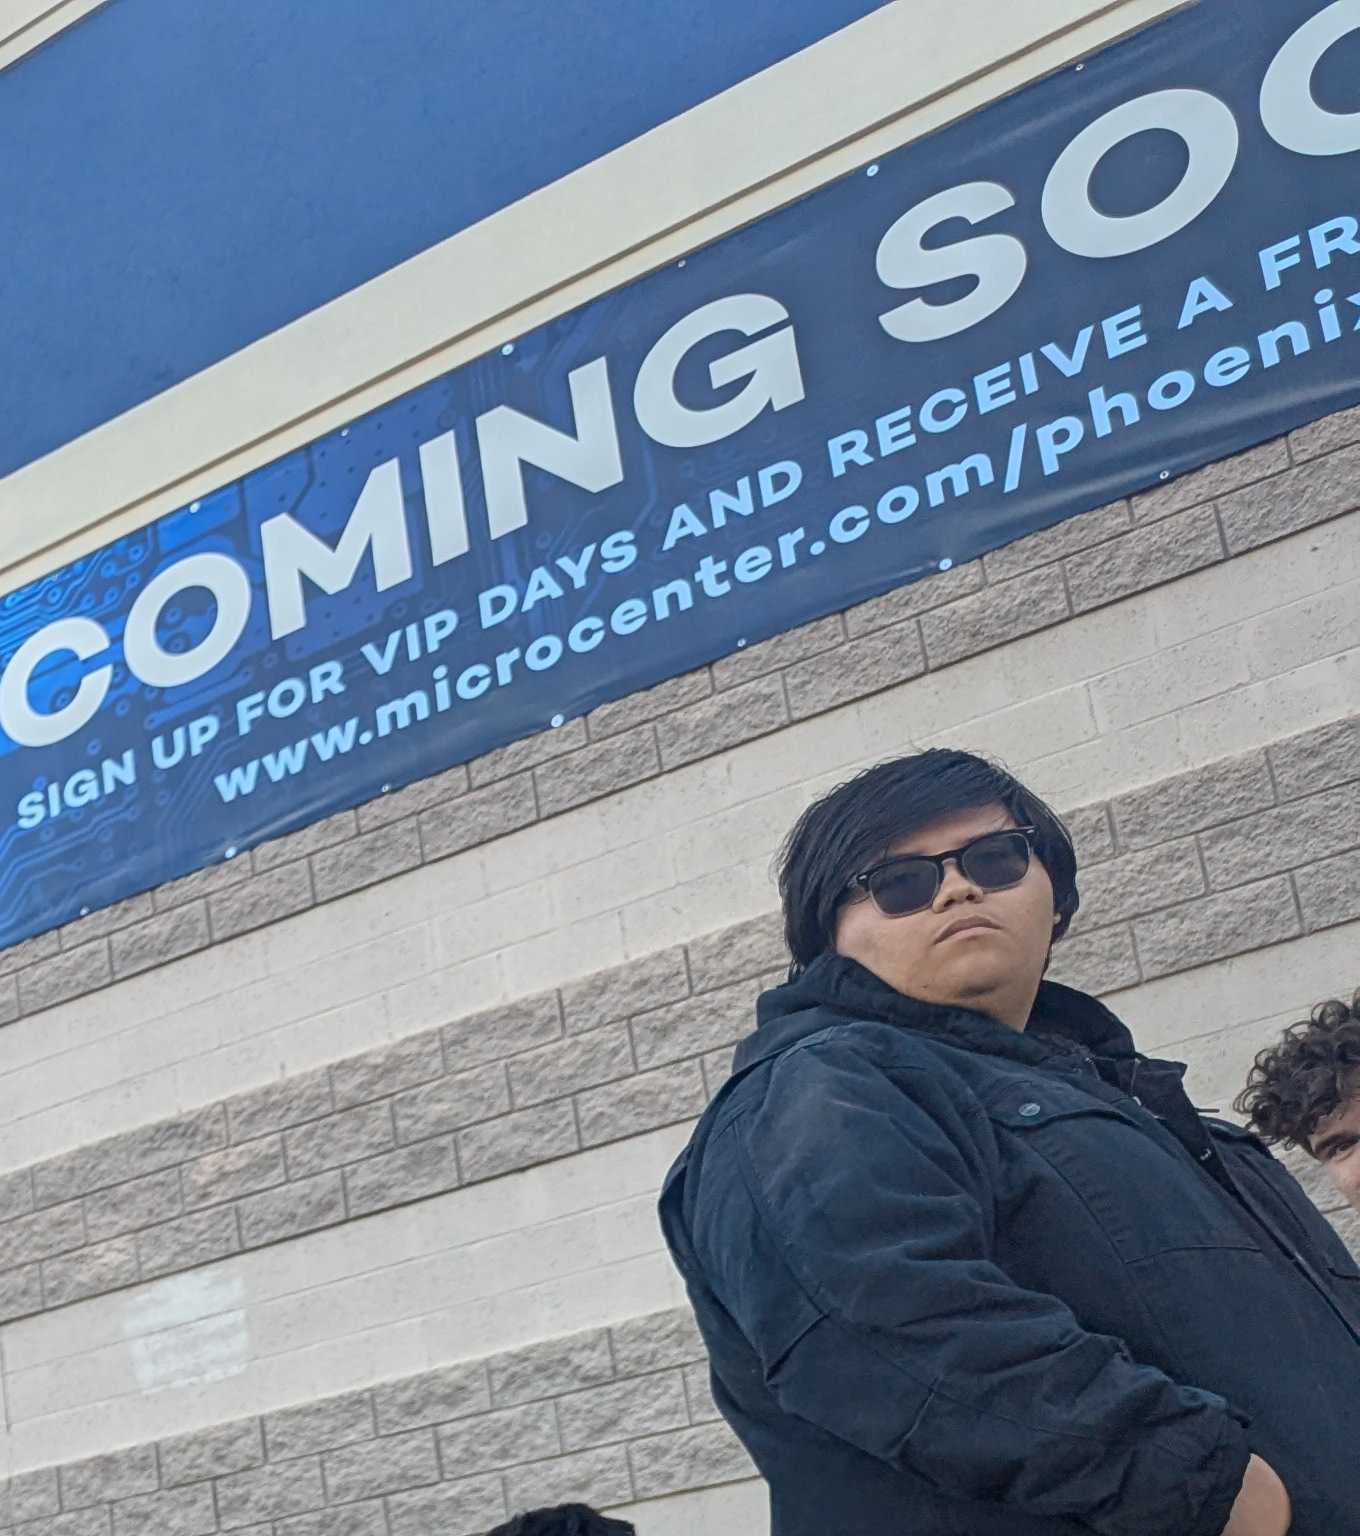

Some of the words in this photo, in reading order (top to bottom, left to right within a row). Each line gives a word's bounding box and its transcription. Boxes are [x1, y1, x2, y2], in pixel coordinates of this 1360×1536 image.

[16, 747, 136, 830] SIGN
[152, 715, 219, 773] UP
[235, 658, 344, 737] FOR
[360, 609, 458, 676] VIP
[479, 529, 638, 630] DAYS
[661, 461, 802, 550] AND
[827, 304, 1148, 478] RECEIVE
[1177, 276, 1233, 329] A
